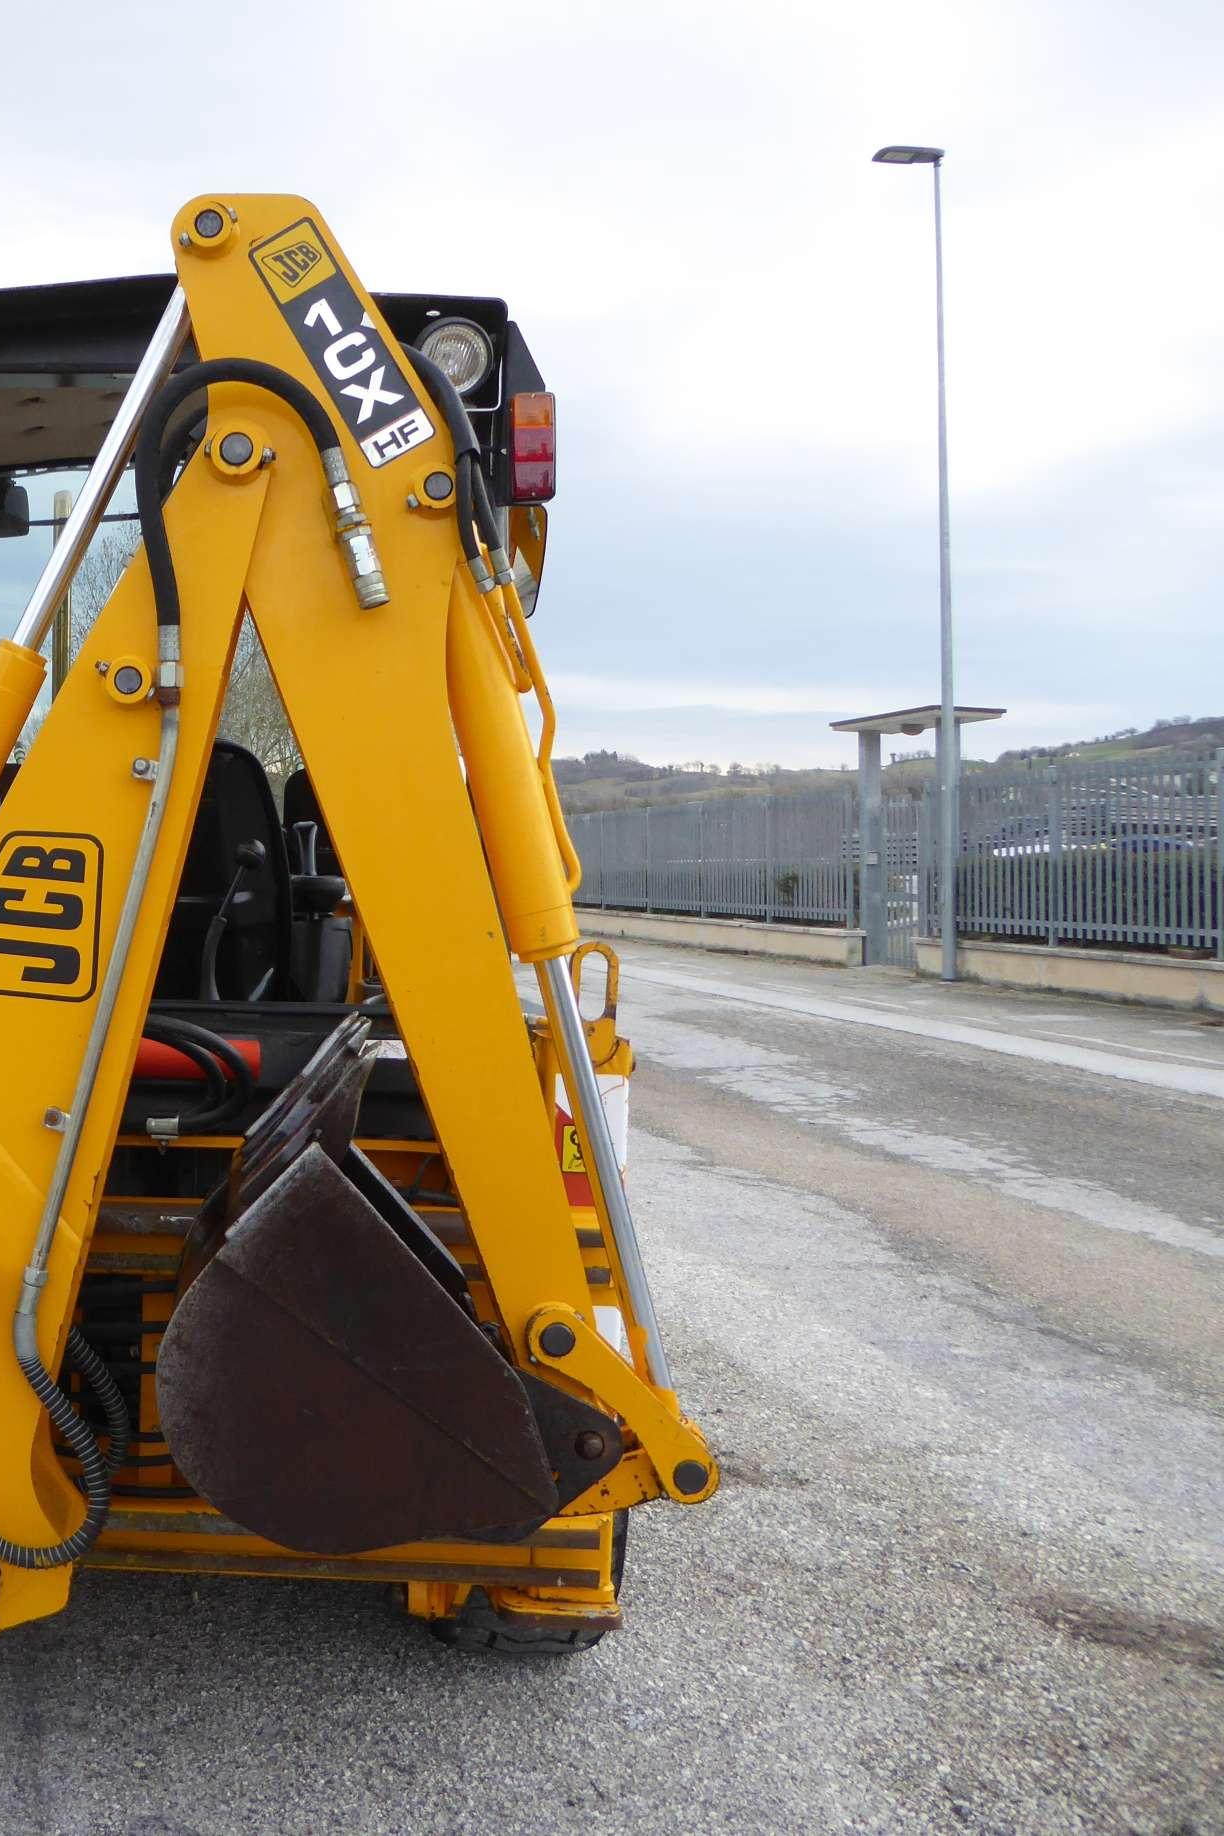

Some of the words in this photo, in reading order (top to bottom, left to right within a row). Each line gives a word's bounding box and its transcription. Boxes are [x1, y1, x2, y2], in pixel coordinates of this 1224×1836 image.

[272, 241, 319, 283] JCB
[303, 298, 405, 425] 1CX
[373, 419, 419, 459] HF
